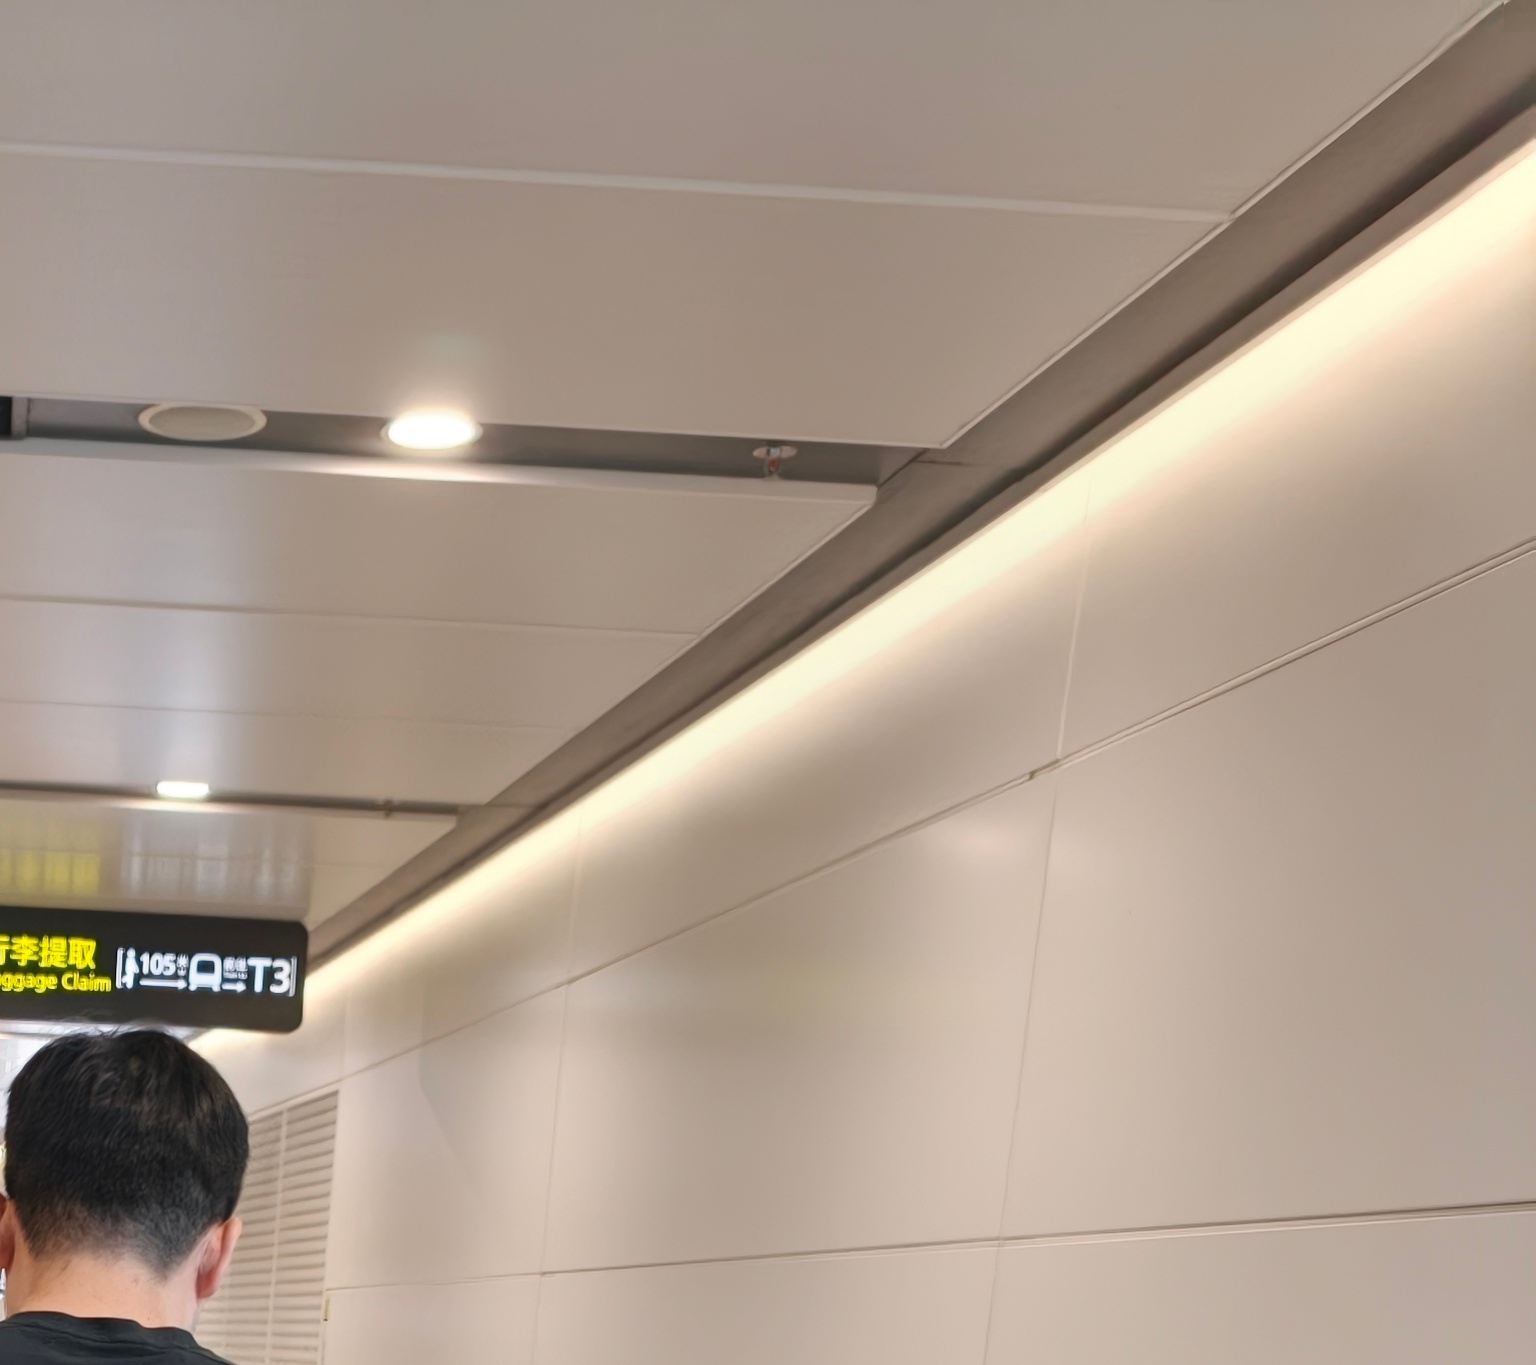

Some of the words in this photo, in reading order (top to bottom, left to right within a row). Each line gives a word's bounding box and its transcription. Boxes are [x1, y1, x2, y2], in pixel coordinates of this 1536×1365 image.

[140, 952, 177, 976] 105
[247, 956, 291, 993] T3
[61, 971, 112, 992] Claim
